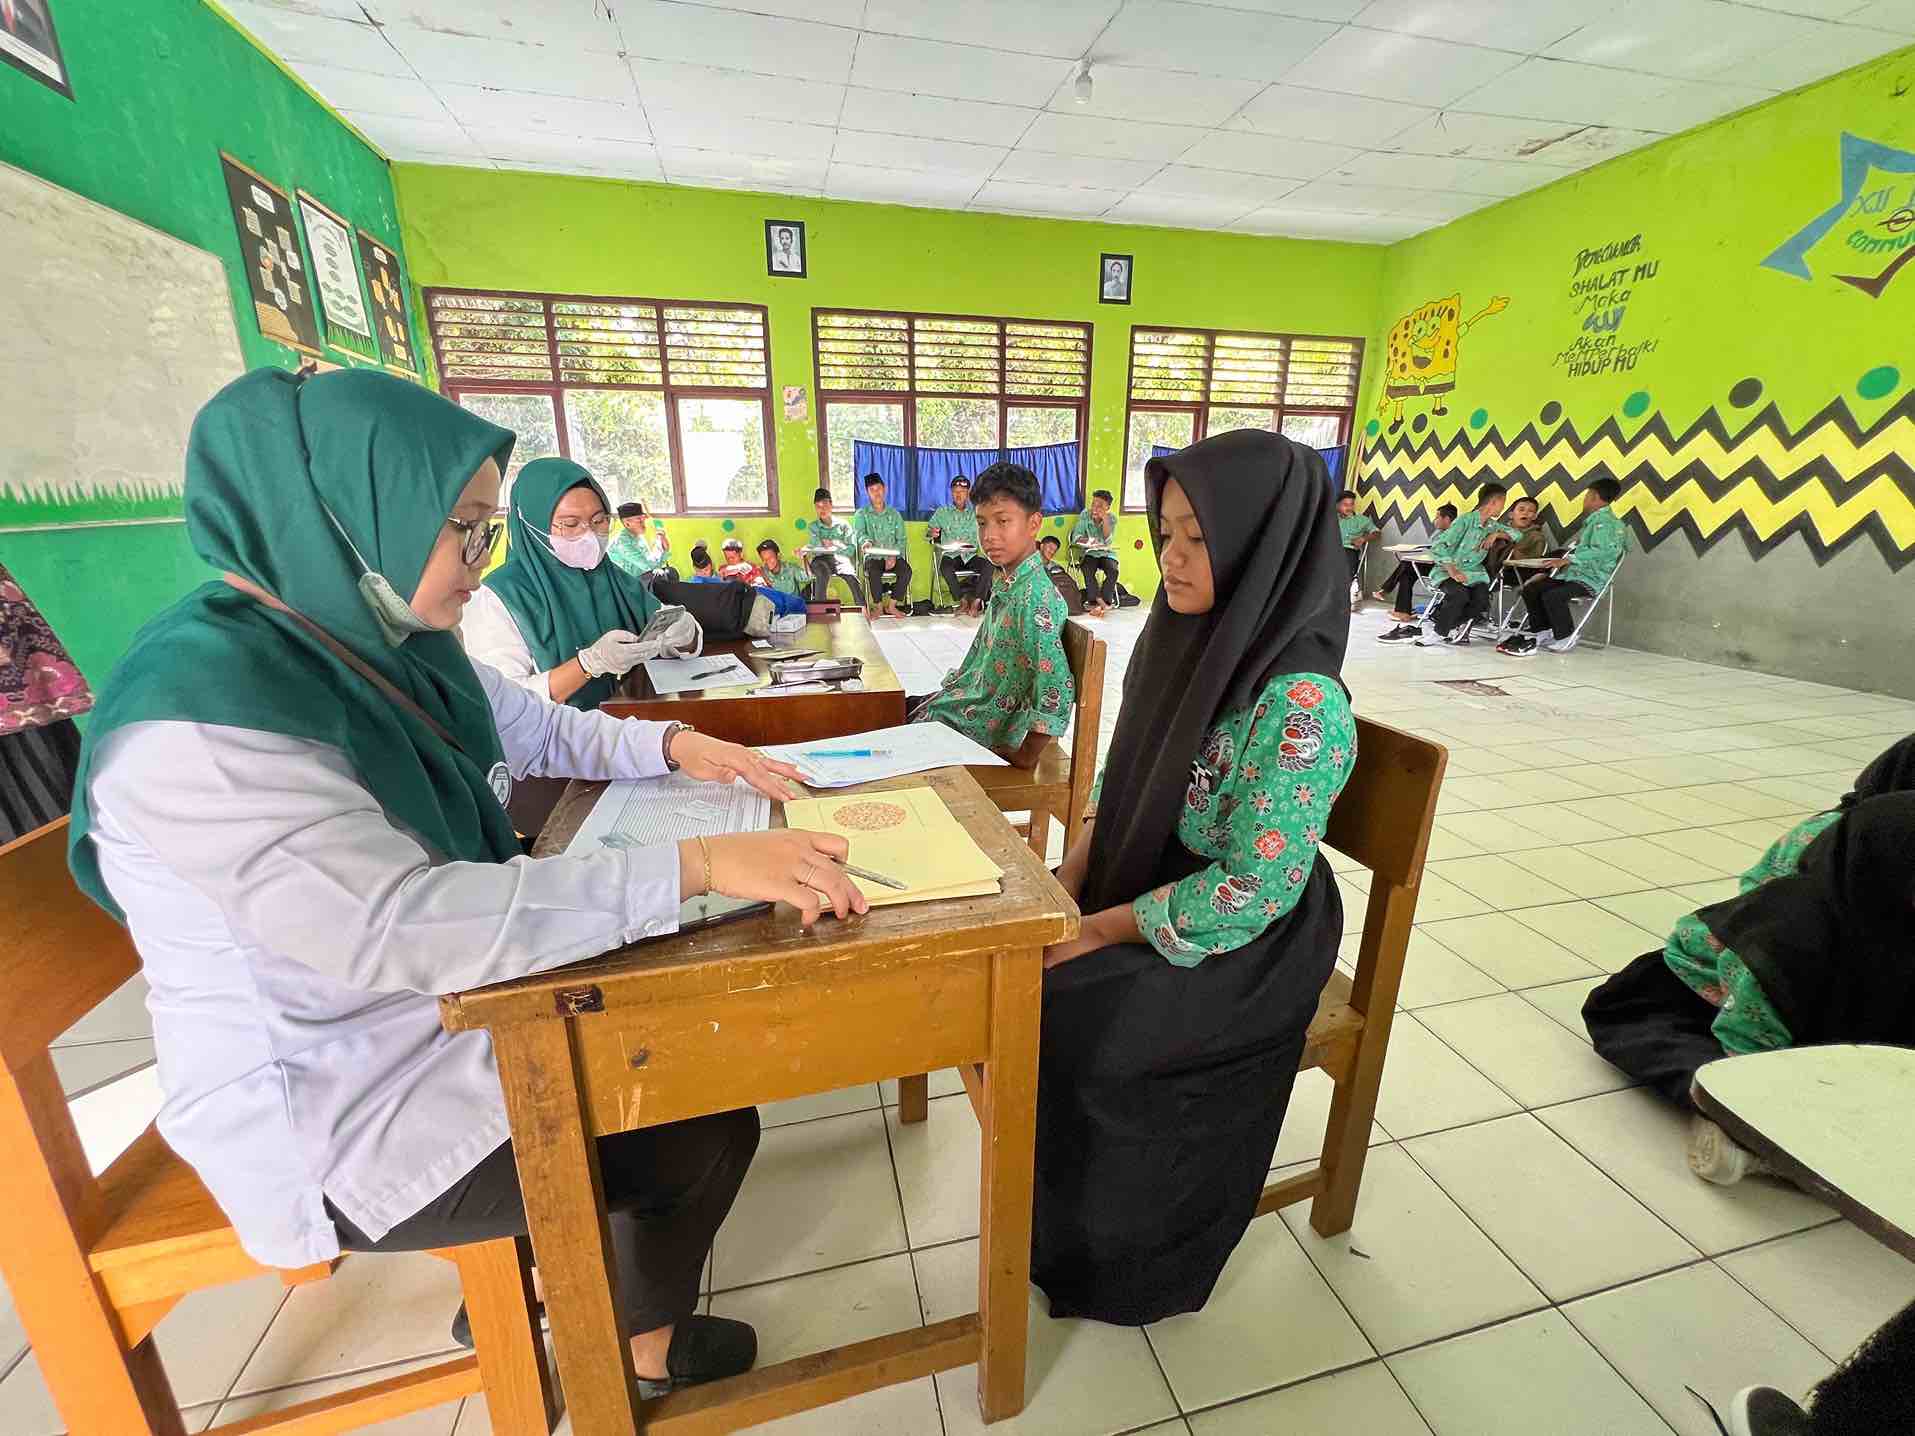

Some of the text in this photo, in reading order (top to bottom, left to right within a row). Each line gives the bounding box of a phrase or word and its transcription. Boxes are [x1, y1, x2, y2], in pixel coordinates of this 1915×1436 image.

[1569, 260, 1660, 297] SHALAT MU
[1568, 359, 1610, 377] HIDUP
